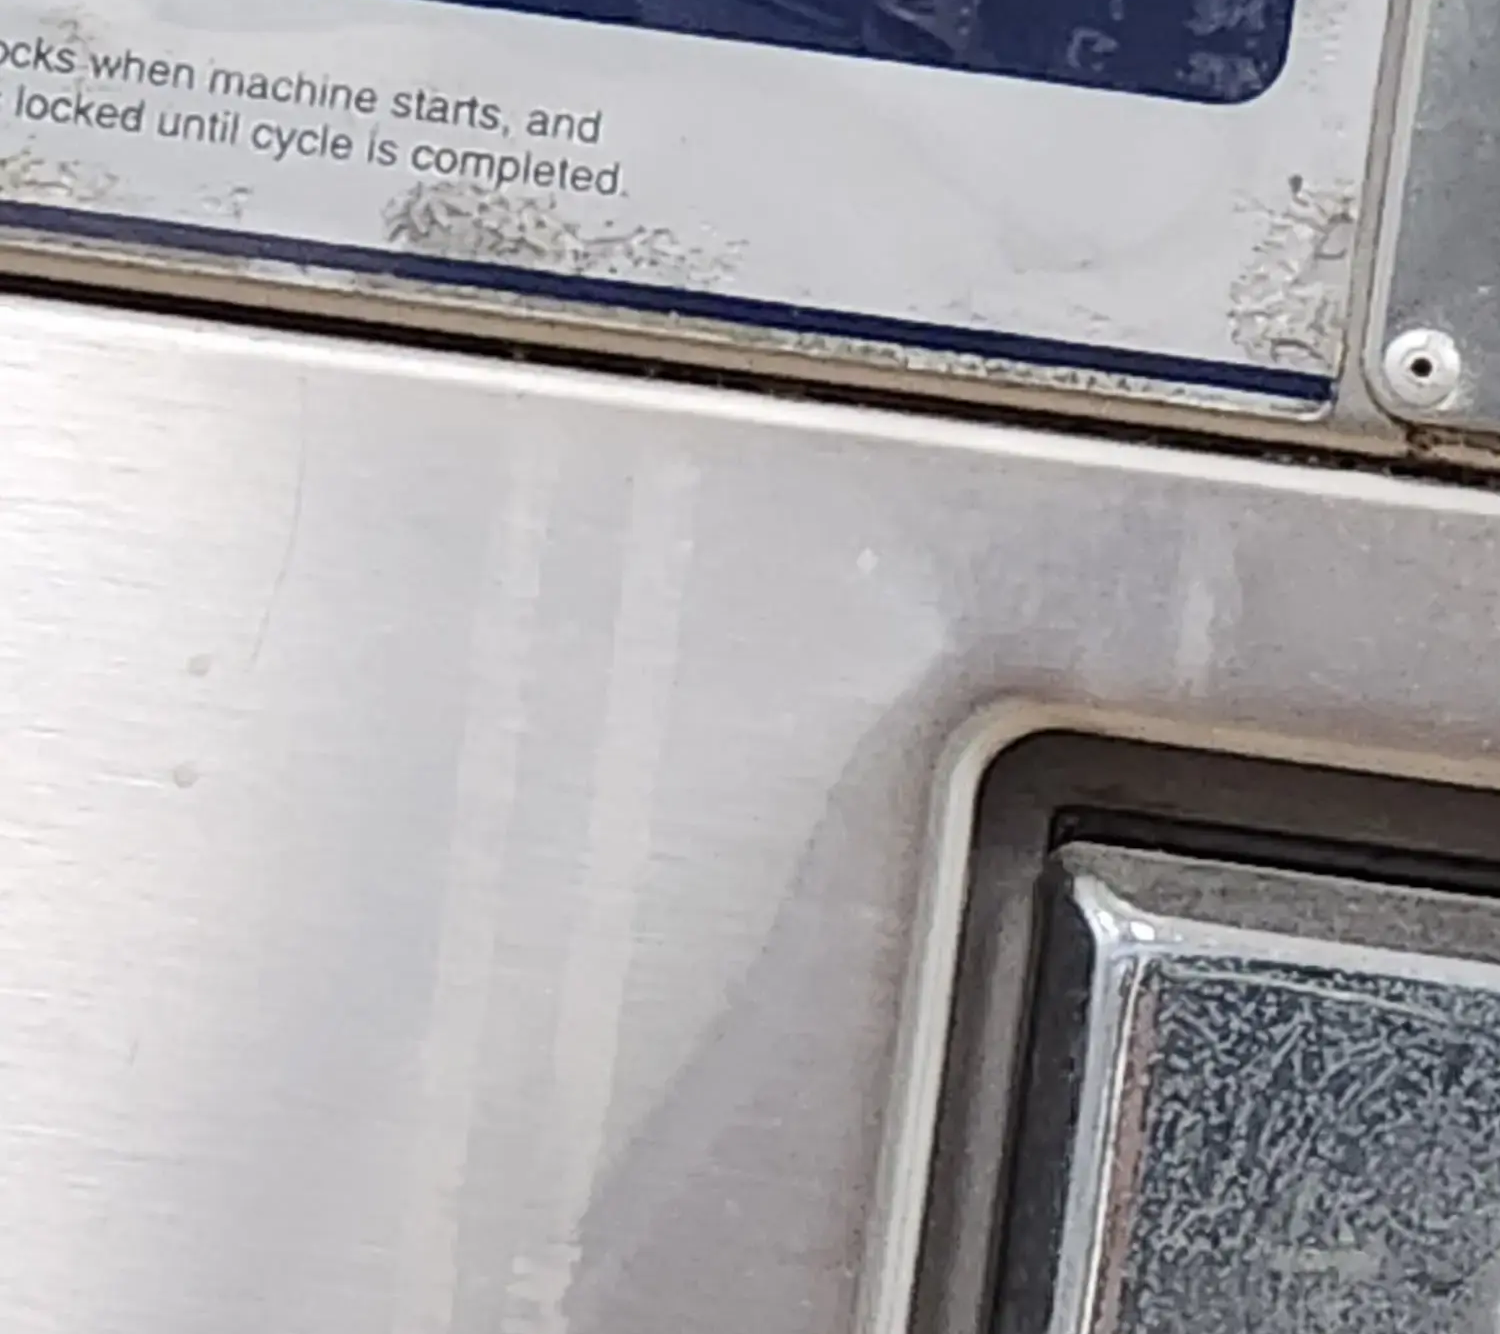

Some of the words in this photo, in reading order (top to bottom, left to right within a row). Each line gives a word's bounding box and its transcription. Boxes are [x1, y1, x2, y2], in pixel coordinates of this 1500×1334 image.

[14, 83, 147, 133] locked
[156, 102, 242, 148] until
[252, 117, 353, 162] cycle
[366, 133, 398, 166] is
[410, 141, 629, 200] completed.
[90, 48, 195, 92] when
[209, 63, 378, 116] machine
[390, 85, 511, 138] starts,
[525, 105, 603, 144] and
